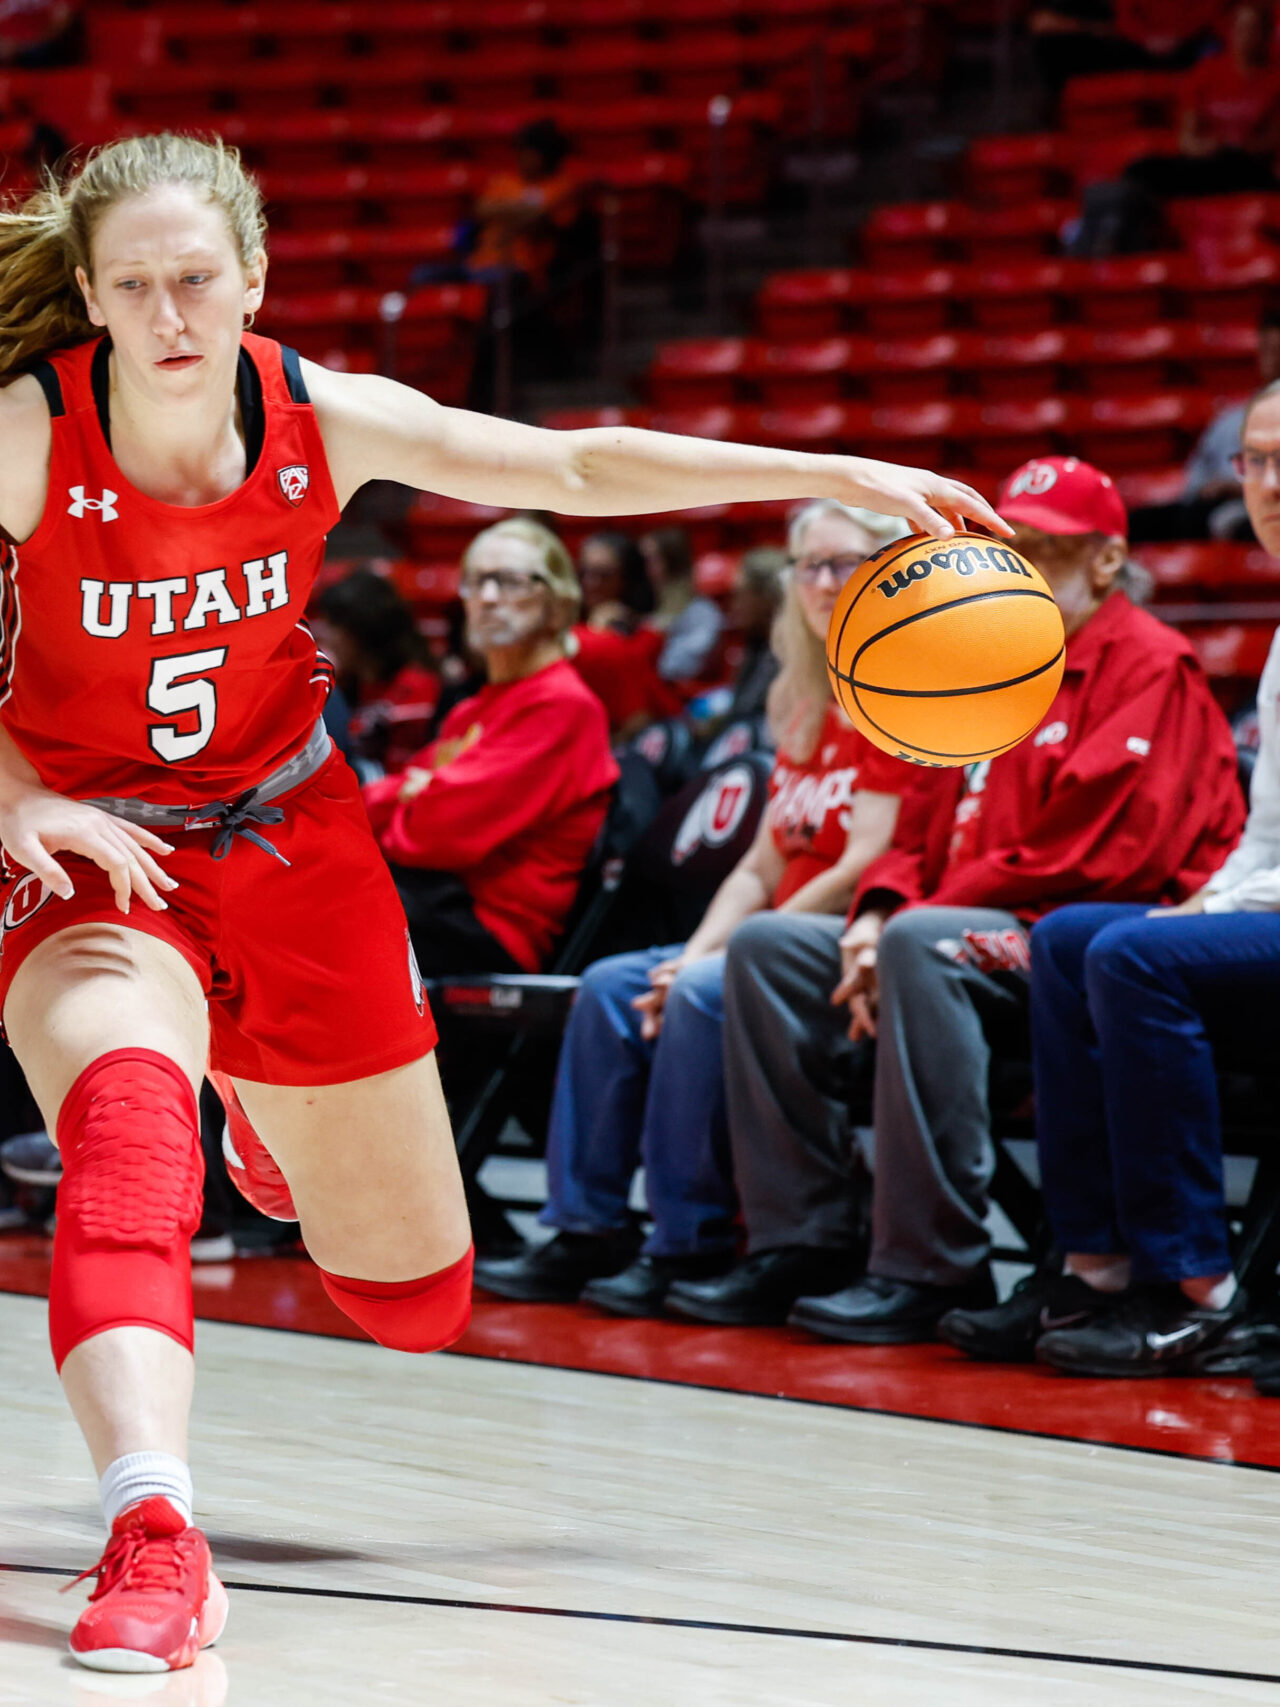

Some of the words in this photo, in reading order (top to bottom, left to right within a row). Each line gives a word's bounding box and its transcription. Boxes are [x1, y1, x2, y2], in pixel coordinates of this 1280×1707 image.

[279, 467, 309, 494] PAC
[80, 550, 290, 639] UTAH
[876, 546, 1033, 599] Wilson
[146, 645, 230, 765] 5
